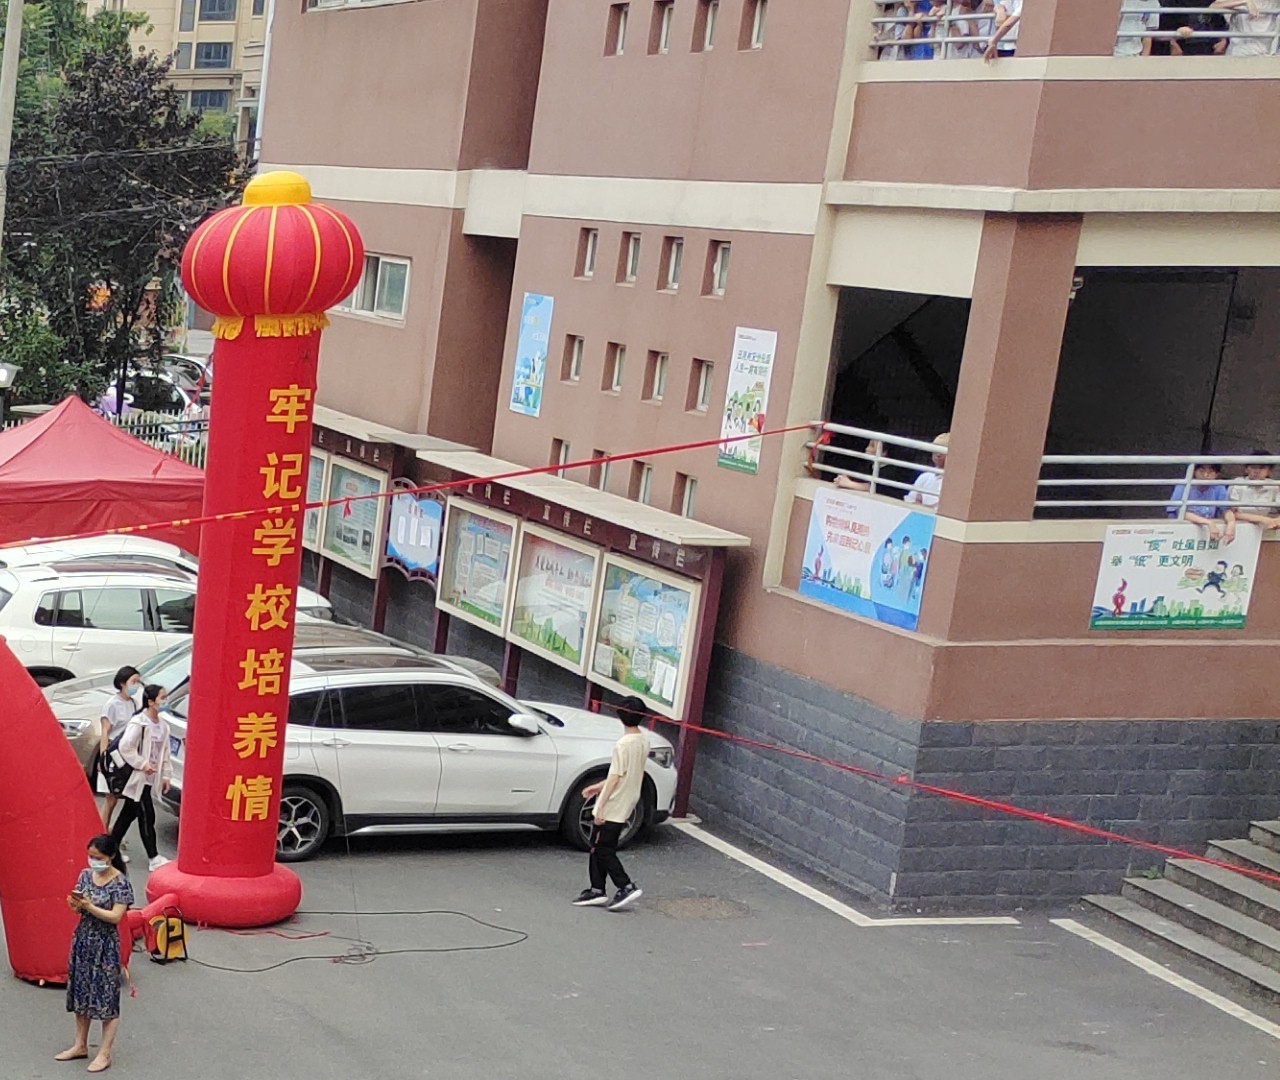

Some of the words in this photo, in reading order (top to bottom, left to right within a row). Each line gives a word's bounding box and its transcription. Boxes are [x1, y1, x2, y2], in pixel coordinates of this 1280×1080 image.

[227, 385, 311, 819] 牢记学校培养情
